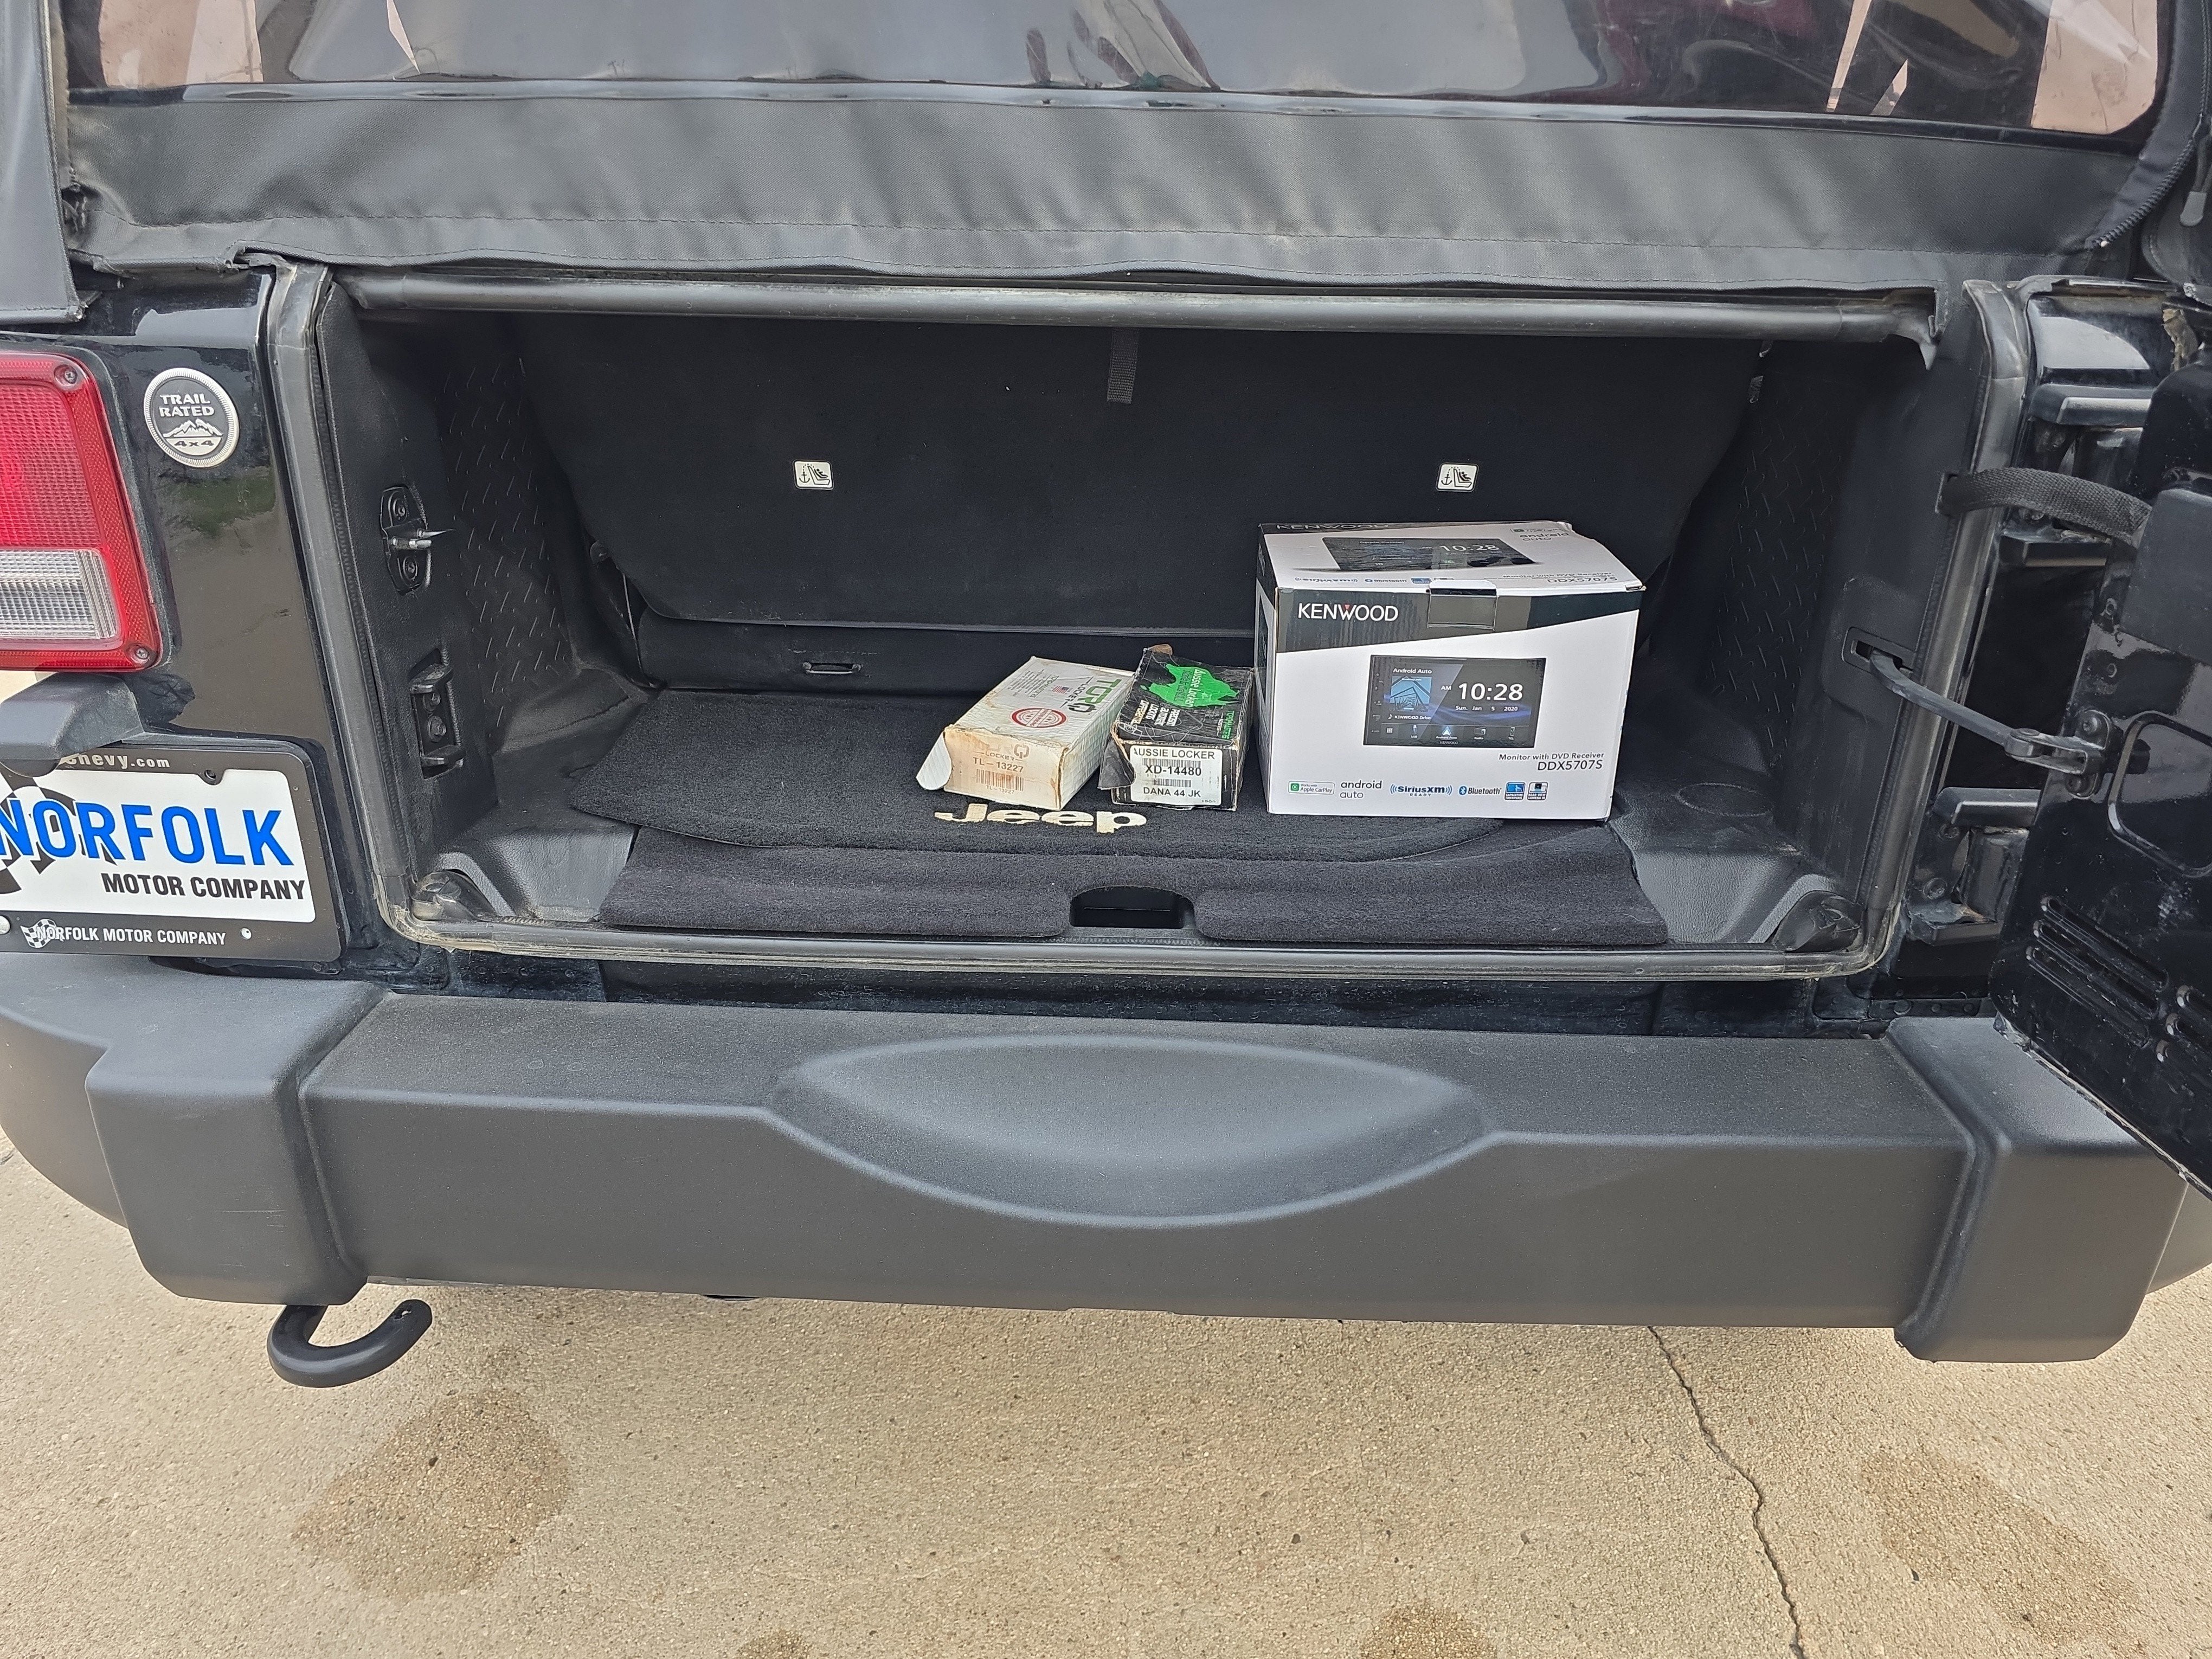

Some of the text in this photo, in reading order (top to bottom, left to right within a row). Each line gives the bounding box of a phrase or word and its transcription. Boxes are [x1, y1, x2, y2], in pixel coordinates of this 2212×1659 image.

[160, 393, 211, 404] TRAIL
[159, 406, 215, 417] RATED
[1298, 603, 1399, 621] KENWOOD
[1065, 684, 1089, 702] LOCKER
[1185, 668, 1206, 708] Aussie Locker
[1458, 683, 1523, 701] 10:28
[1068, 679, 1122, 713] TORQ
[985, 751, 1015, 761] LOCKER
[1172, 750, 1215, 759] LOCKER
[1144, 765, 1202, 776] XD-14480
[1537, 760, 1603, 770] DDX5707S
[1341, 780, 1382, 789] android
[1143, 787, 1171, 796] DANA
[1340, 790, 1364, 799] auto
[1468, 787, 1501, 795] Bluetooth
[935, 803, 1147, 833] Jeep
[0, 799, 294, 866] NORFOLK
[101, 872, 305, 900] MOTOR COMPANY
[36, 925, 226, 945] NORFOLK MOTOR COMPANY
